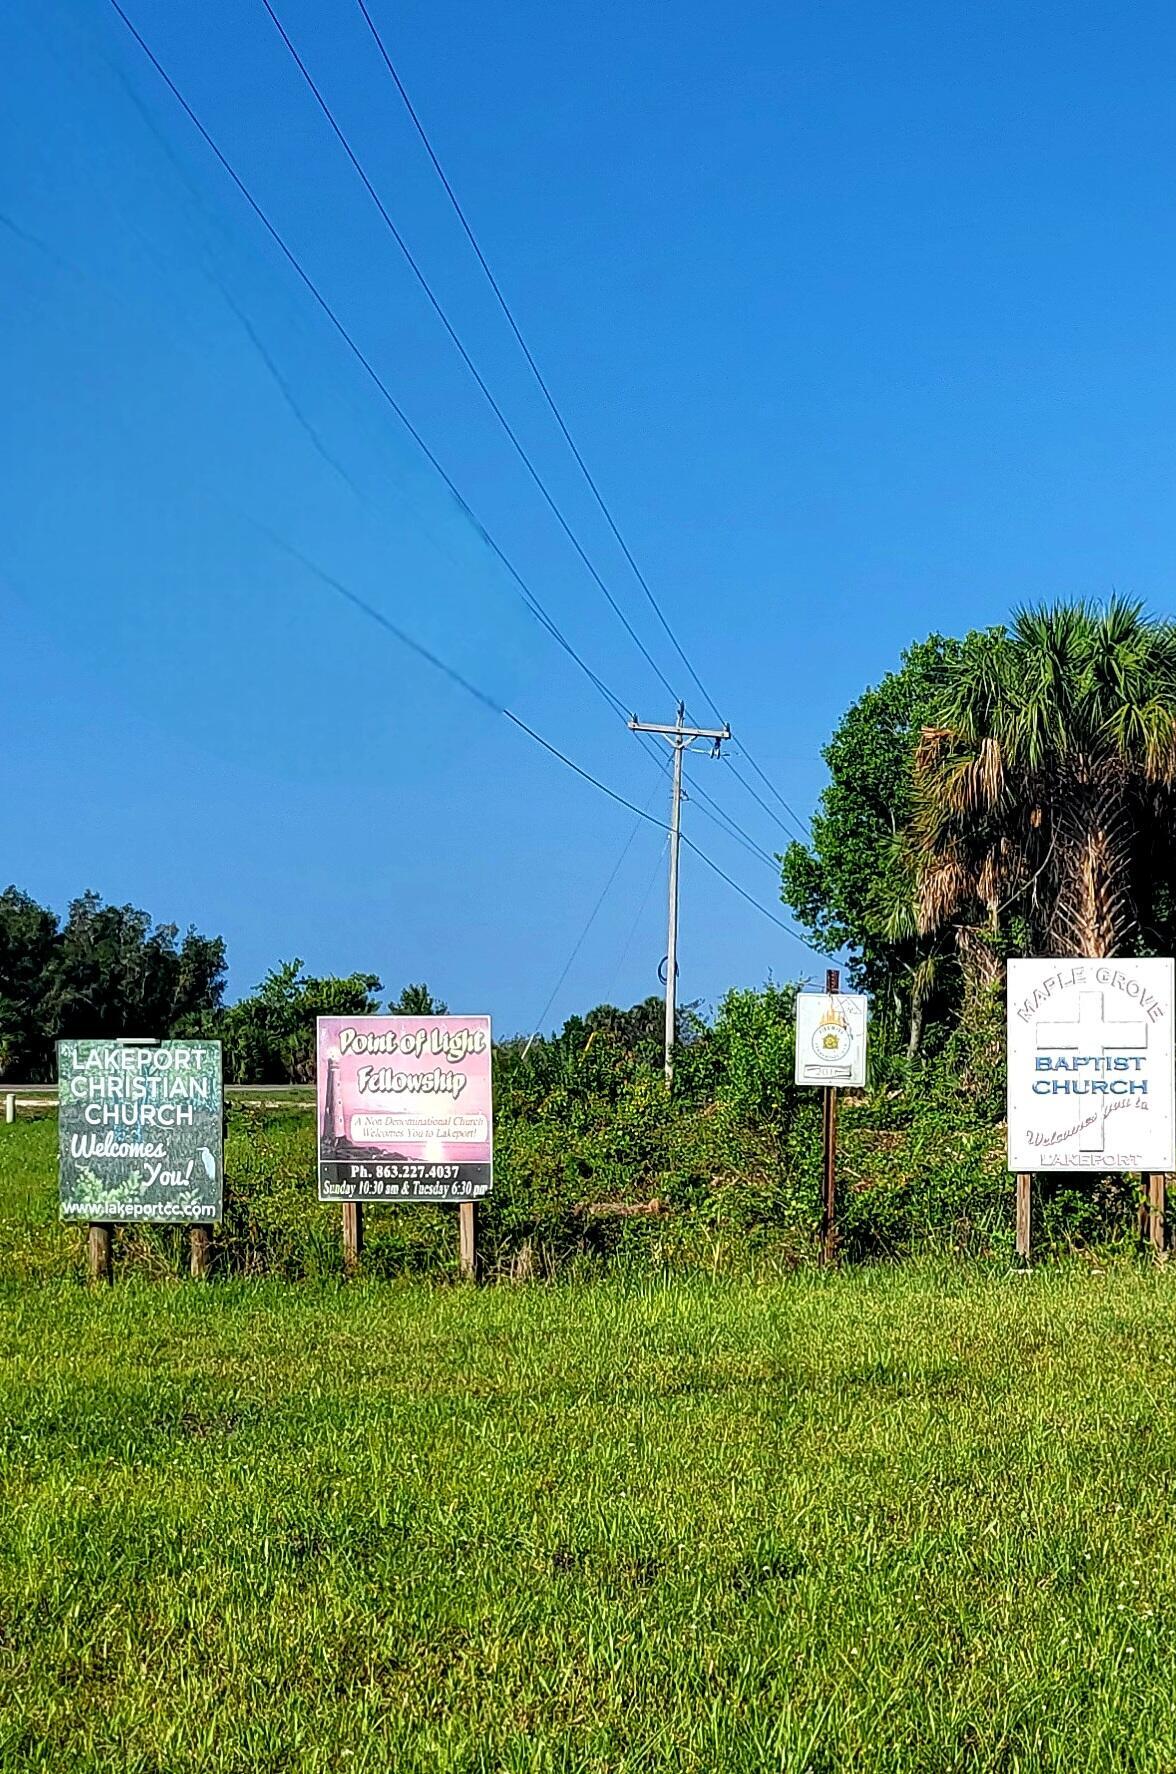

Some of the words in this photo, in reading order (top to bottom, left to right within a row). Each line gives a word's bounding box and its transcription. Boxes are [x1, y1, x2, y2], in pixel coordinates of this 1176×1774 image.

[1017, 967, 1087, 1023] MAPLE
[1095, 967, 1163, 1023] GROVE
[339, 1027, 397, 1055] Point
[400, 1029, 427, 1059] of
[431, 1027, 486, 1063] Light
[72, 1049, 207, 1070] LAKEPORT
[1035, 1056, 1147, 1071] BAPTIST
[70, 1076, 208, 1098] CHRISTIAN
[358, 1065, 467, 1100] Fellowship
[1032, 1079, 1148, 1095] CHURCH
[84, 1104, 193, 1126] CHURCH
[354, 1117, 362, 1126] A
[365, 1117, 382, 1126] Non
[452, 1116, 484, 1126] Church
[363, 1129, 405, 1138] Welcomes
[407, 1129, 423, 1138] You
[424, 1129, 433, 1138] to
[436, 1128, 477, 1140] Lakeport!
[71, 1131, 167, 1158] Welcomes
[1040, 1153, 1142, 1167] LAKEPORT
[142, 1160, 194, 1187] You!
[351, 1165, 372, 1178] Ph.
[376, 1165, 460, 1179] 863.227.4037
[323, 1180, 356, 1197] Sunday
[358, 1181, 383, 1195] 10:30
[385, 1183, 399, 1195] am
[401, 1182, 410, 1195] &
[412, 1182, 450, 1197] Tuesday
[452, 1181, 472, 1195] 6:30
[473, 1184, 488, 1197] pm
[63, 1200, 216, 1217] www.lakeportcc.com
